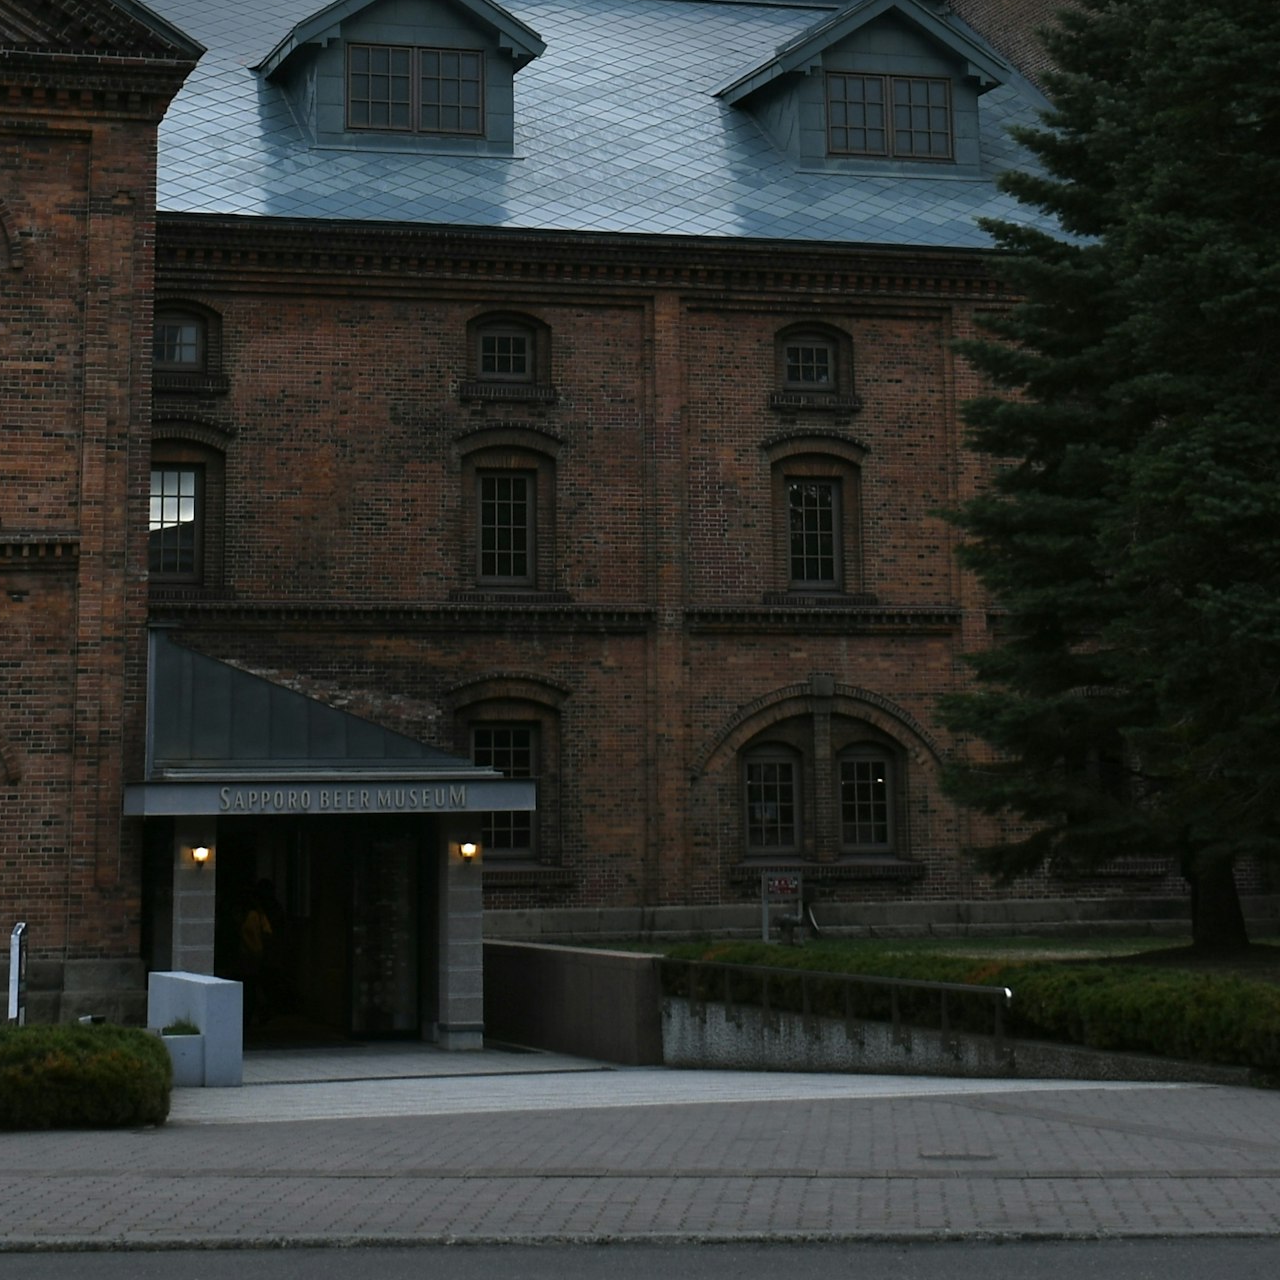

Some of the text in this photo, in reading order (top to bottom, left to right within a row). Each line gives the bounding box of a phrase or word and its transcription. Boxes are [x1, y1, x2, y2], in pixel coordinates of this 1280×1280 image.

[219, 784, 468, 811] SAPPORO BEER MUSEUM
